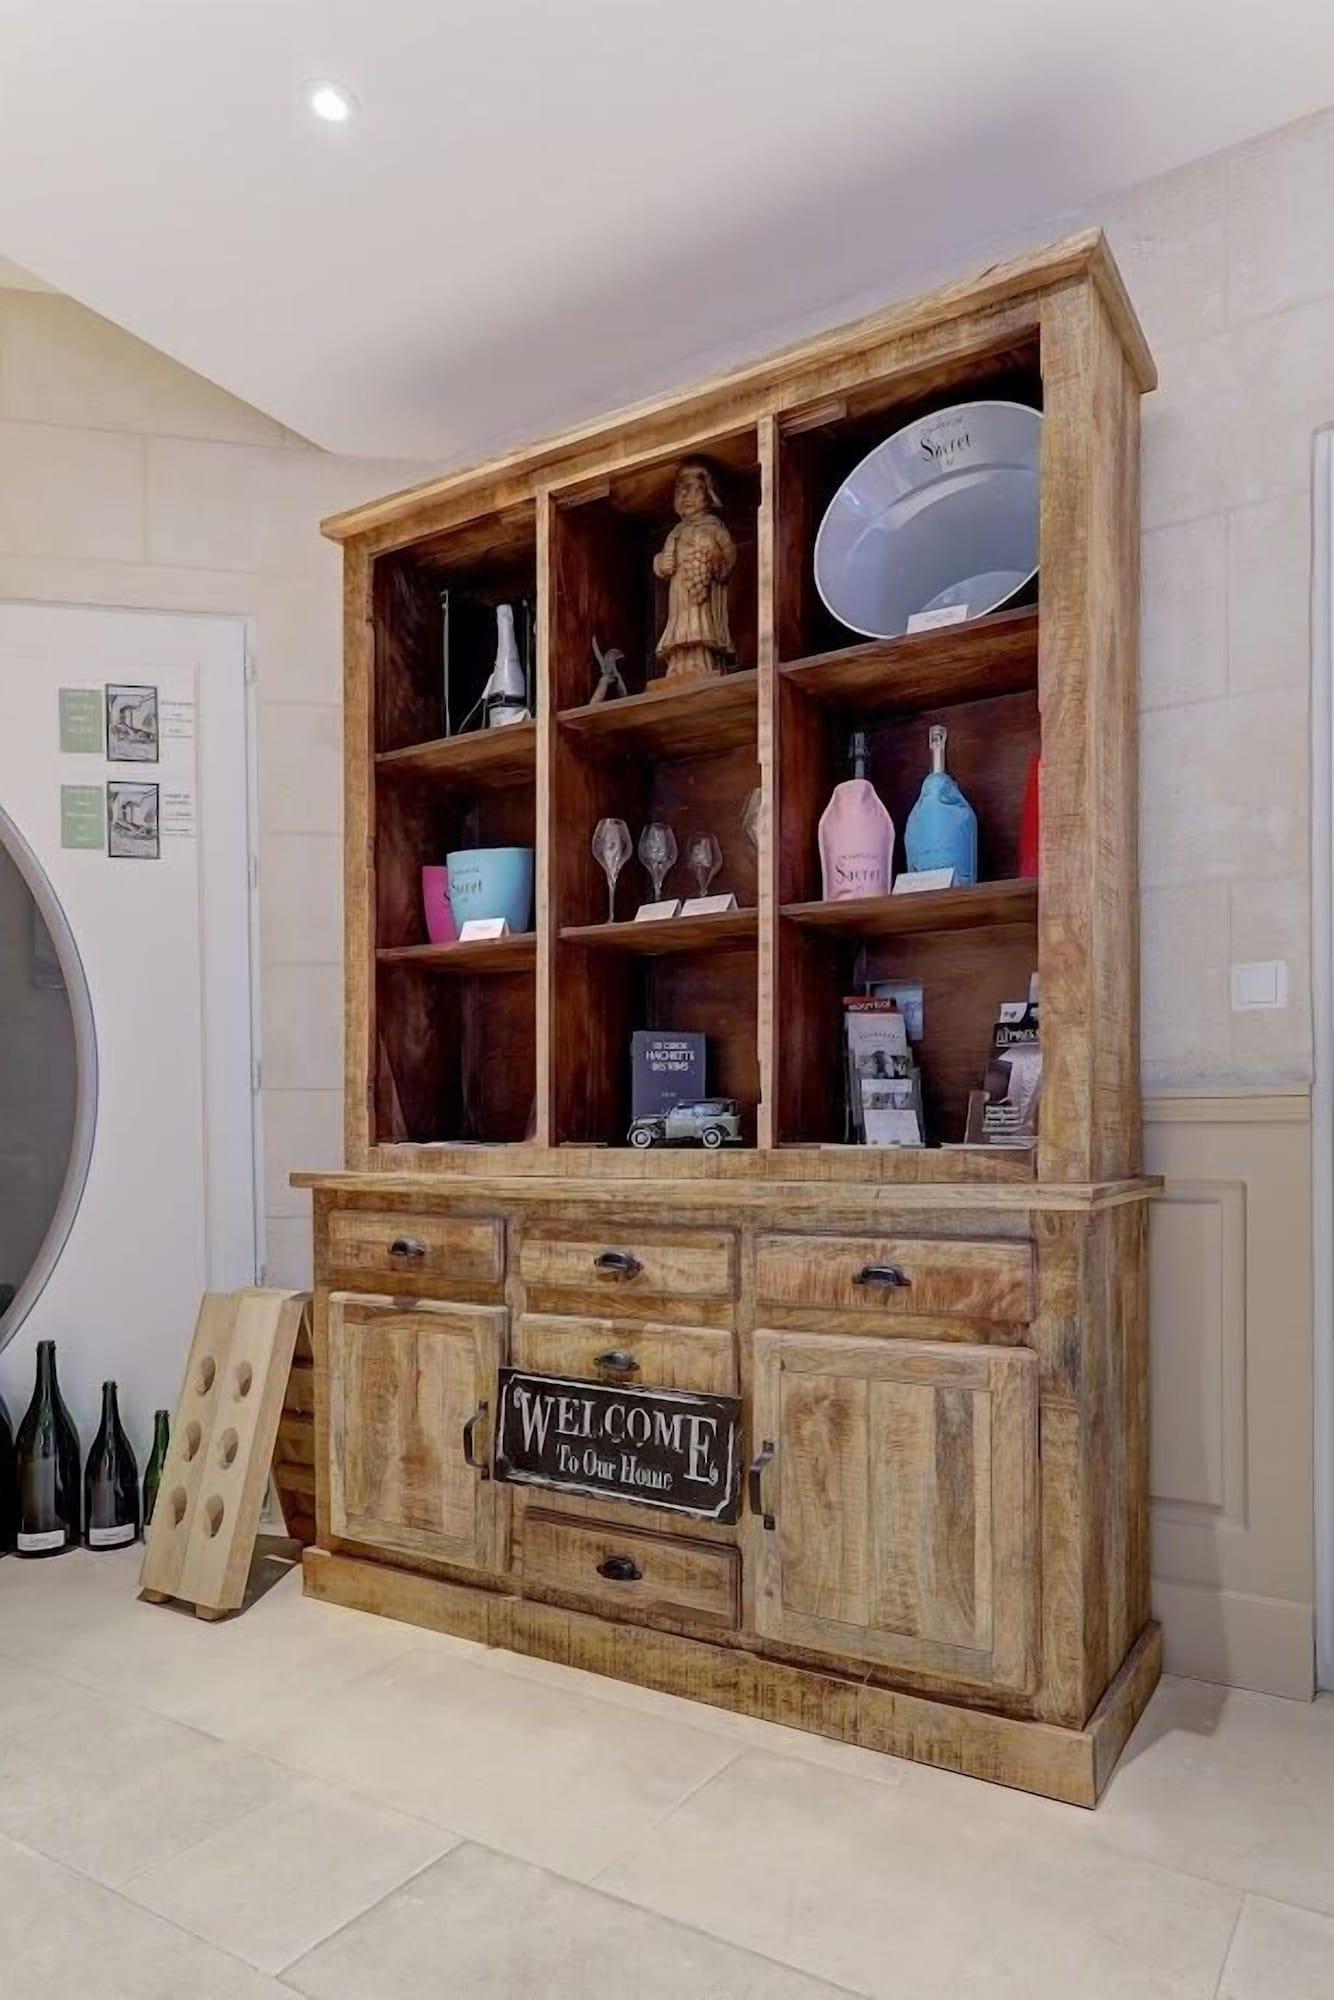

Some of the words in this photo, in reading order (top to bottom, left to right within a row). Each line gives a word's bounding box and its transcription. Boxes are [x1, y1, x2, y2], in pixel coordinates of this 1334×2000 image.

[513, 1387, 719, 1486] WELCOME
[556, 1443, 579, 1474] To
[582, 1448, 617, 1481] Our
[620, 1453, 674, 1492] Home
